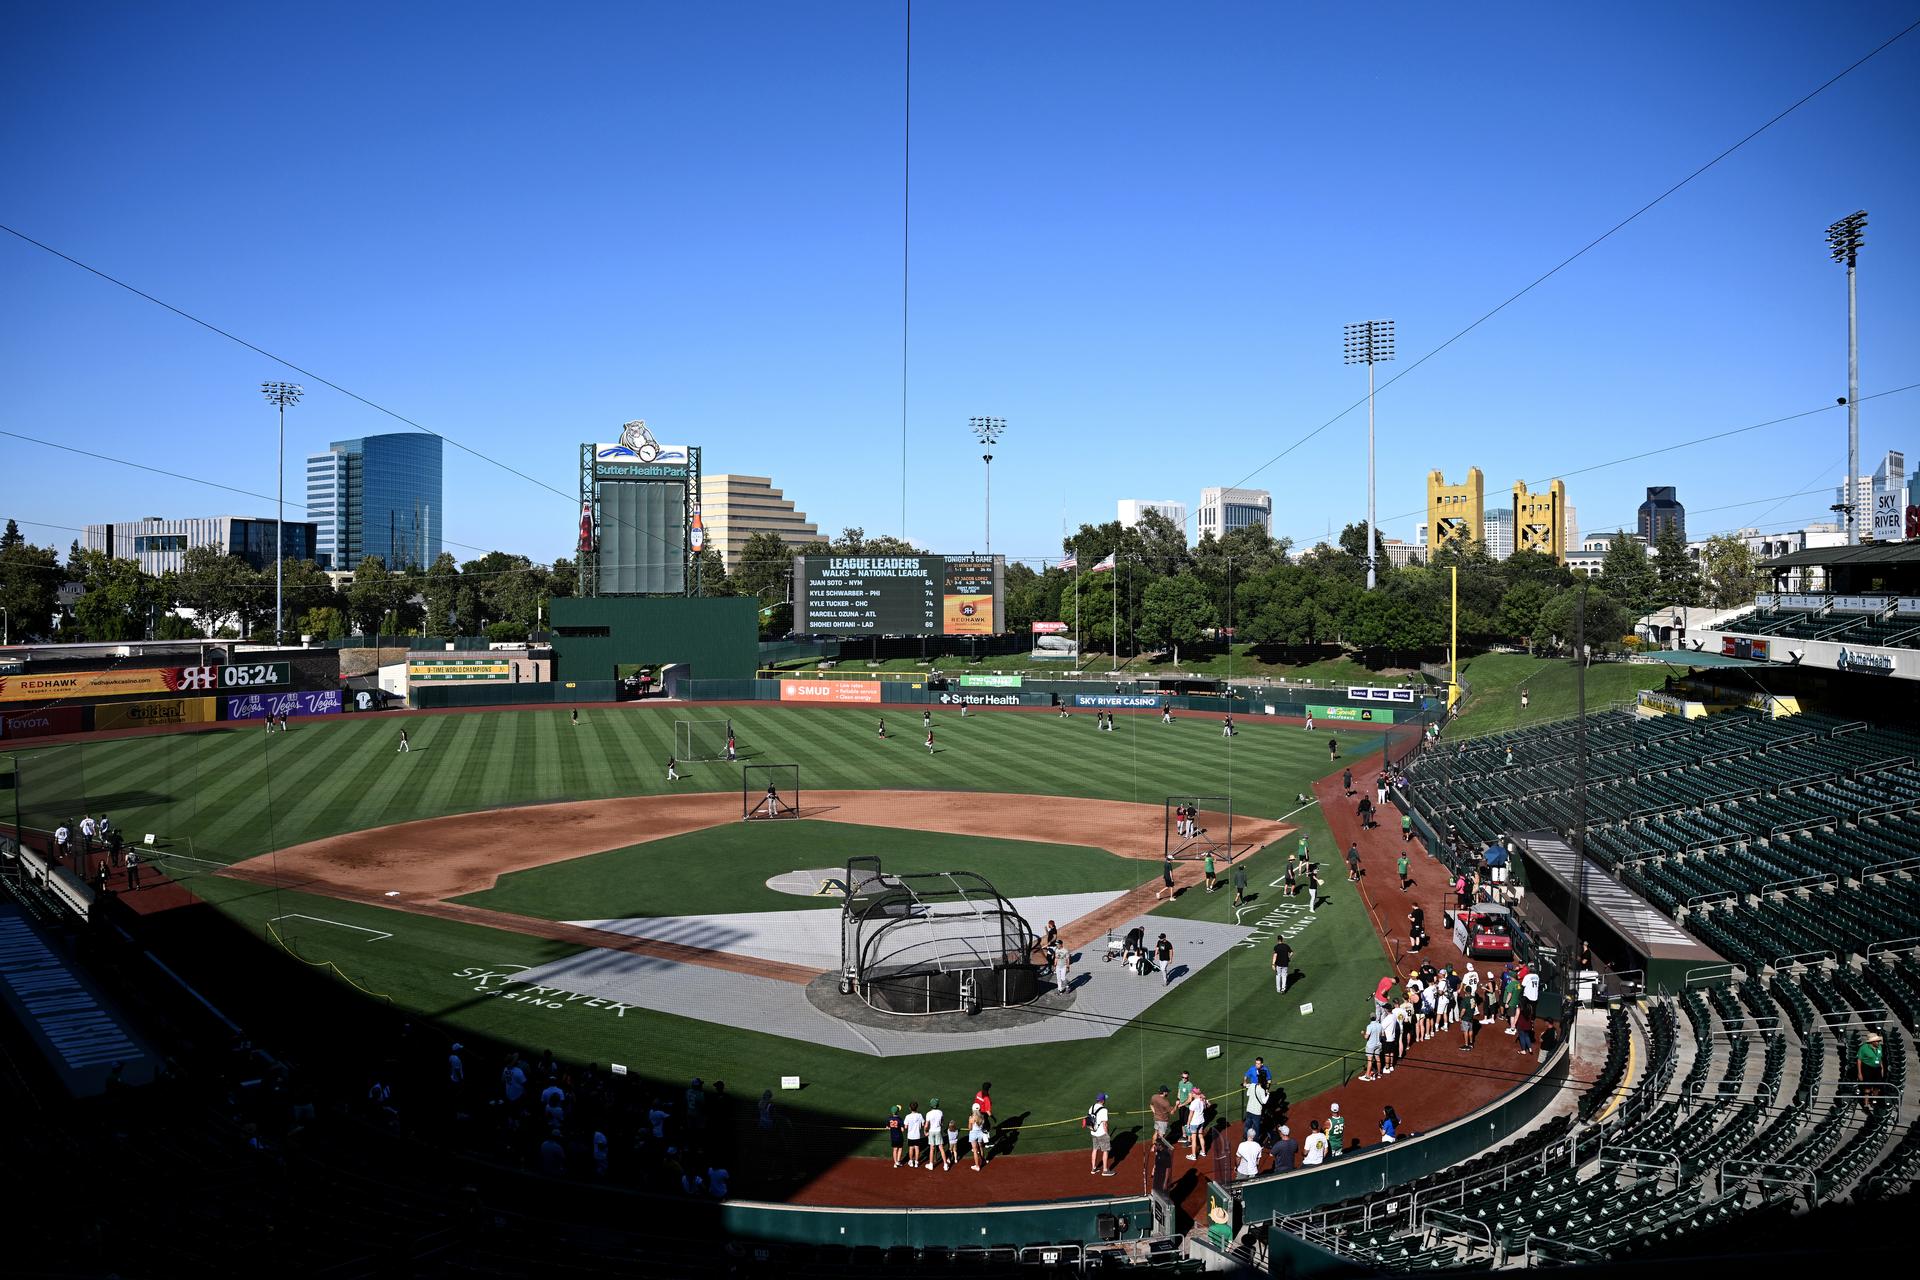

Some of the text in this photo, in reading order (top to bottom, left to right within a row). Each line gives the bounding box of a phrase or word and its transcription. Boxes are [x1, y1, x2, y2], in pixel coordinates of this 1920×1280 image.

[597, 465, 687, 477] Sutter Health Park
[1879, 495, 1896, 508] SKY
[1875, 514, 1900, 528] RIVER
[830, 558, 920, 569] LEAGUE LEADERS
[1850, 652, 1892, 668] Sutter Health
[20, 678, 151, 689] REDHAWK redhawkcasino.com
[225, 665, 278, 686] 05:24
[798, 687, 830, 695] SMUD
[952, 694, 1019, 704] Sutter Health
[128, 701, 186, 719] Golden 1
[229, 697, 264, 718] Vegas
[268, 695, 303, 717] Vegas
[306, 693, 340, 713] Vegas
[8, 718, 49, 729] TOYOTA
[1256, 903, 1310, 928] RIVER
[1281, 916, 1316, 938] CASINO
[452, 967, 517, 985] SKY
[474, 986, 563, 1009] CASINO
[1333, 1124, 1343, 1134] 25
